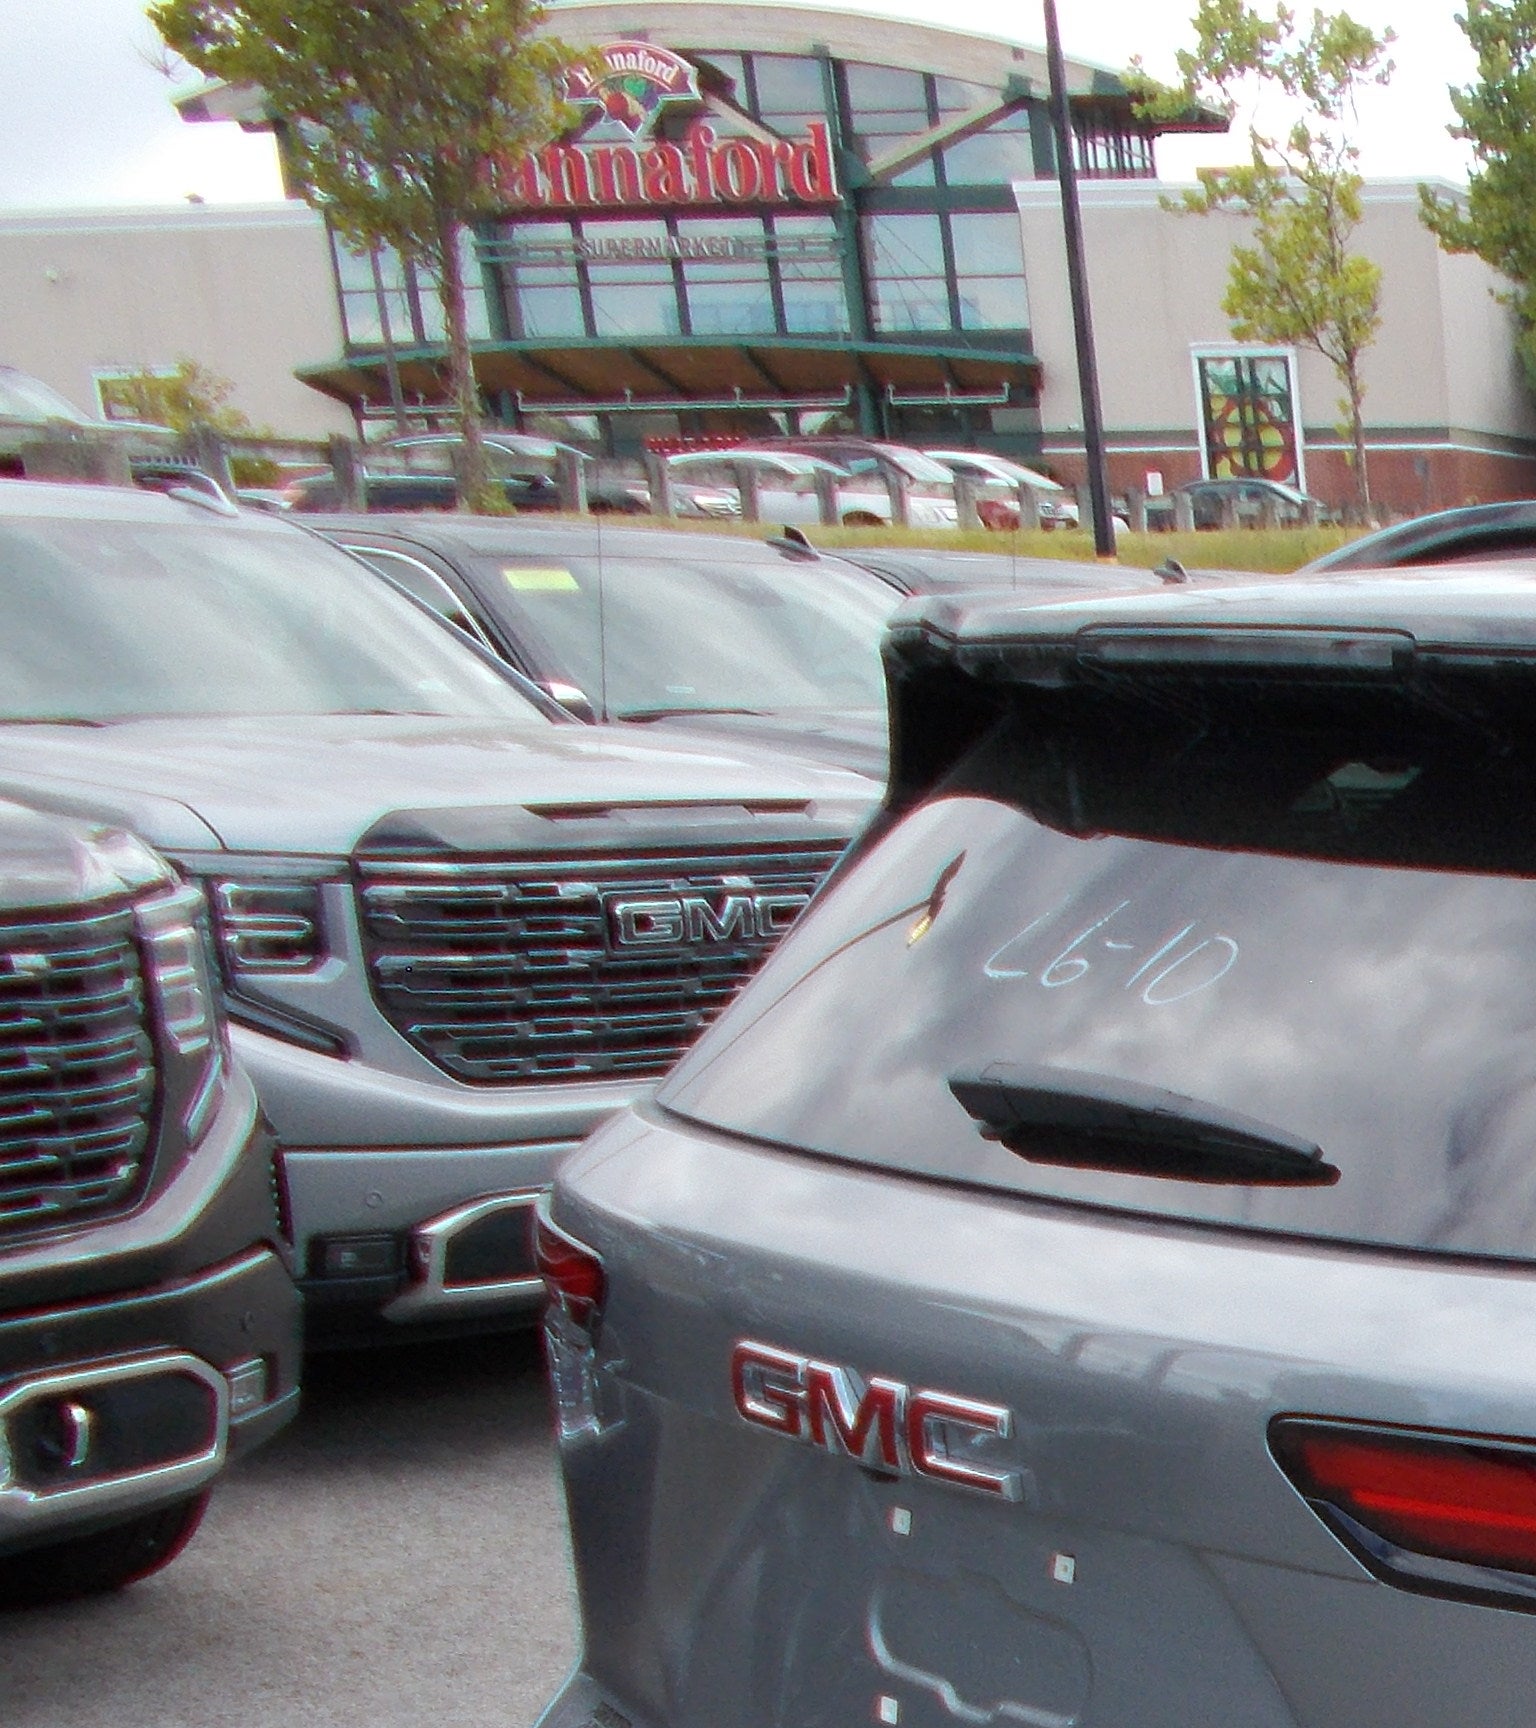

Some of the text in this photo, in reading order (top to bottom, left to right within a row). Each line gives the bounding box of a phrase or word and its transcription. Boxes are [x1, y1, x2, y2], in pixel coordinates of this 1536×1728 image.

[576, 235, 736, 258] SUPERMARKET
[616, 895, 811, 944] GMC
[731, 1341, 1023, 1501] GMC
